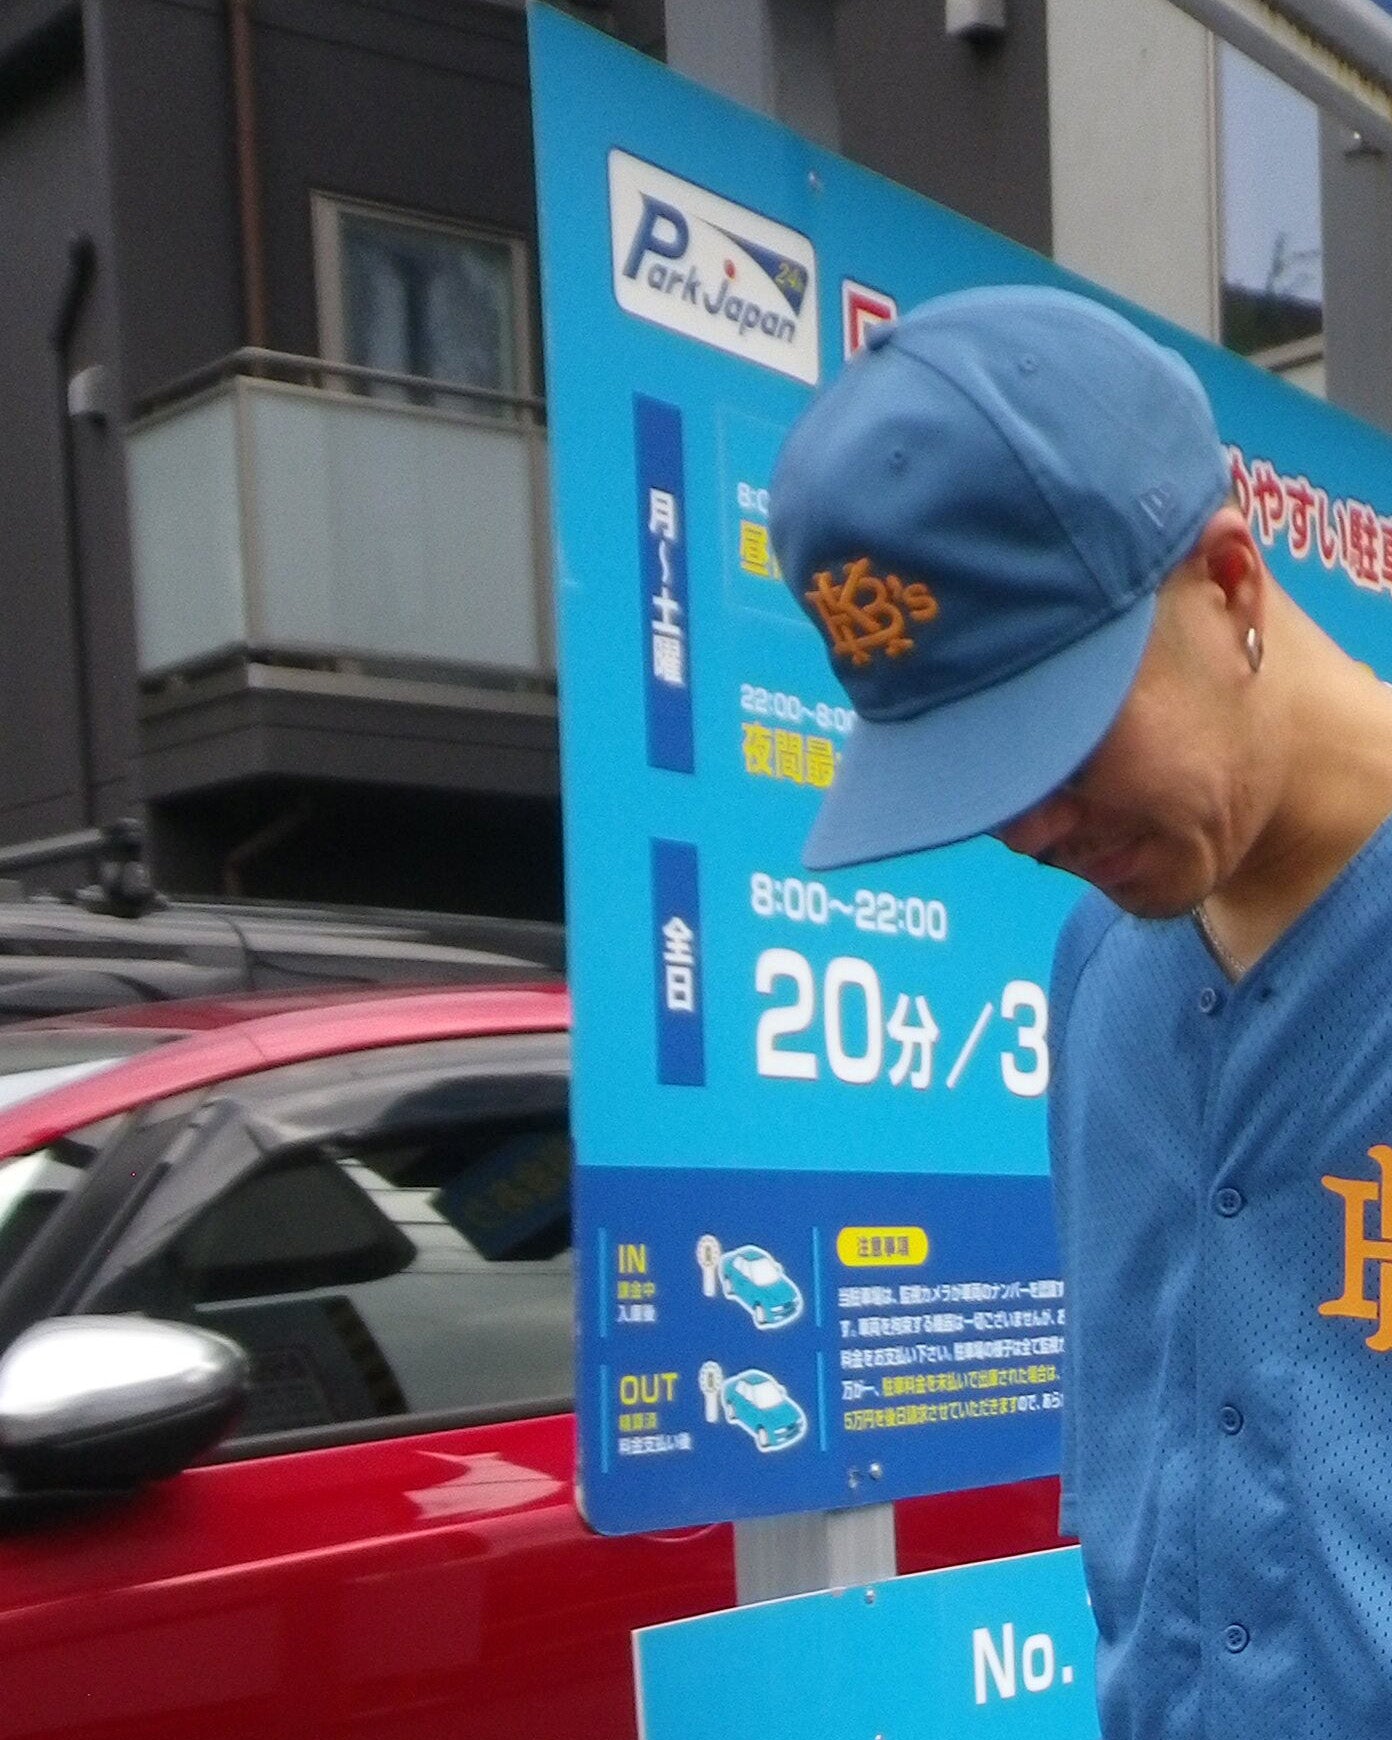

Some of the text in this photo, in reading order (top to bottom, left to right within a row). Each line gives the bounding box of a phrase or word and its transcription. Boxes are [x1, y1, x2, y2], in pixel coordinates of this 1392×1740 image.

[623, 191, 796, 343] Park Japan
[662, 916, 694, 1013] 全日
[618, 1243, 647, 1274] IN
[619, 1372, 678, 1406] OUT
[972, 1621, 1075, 1705] No.
